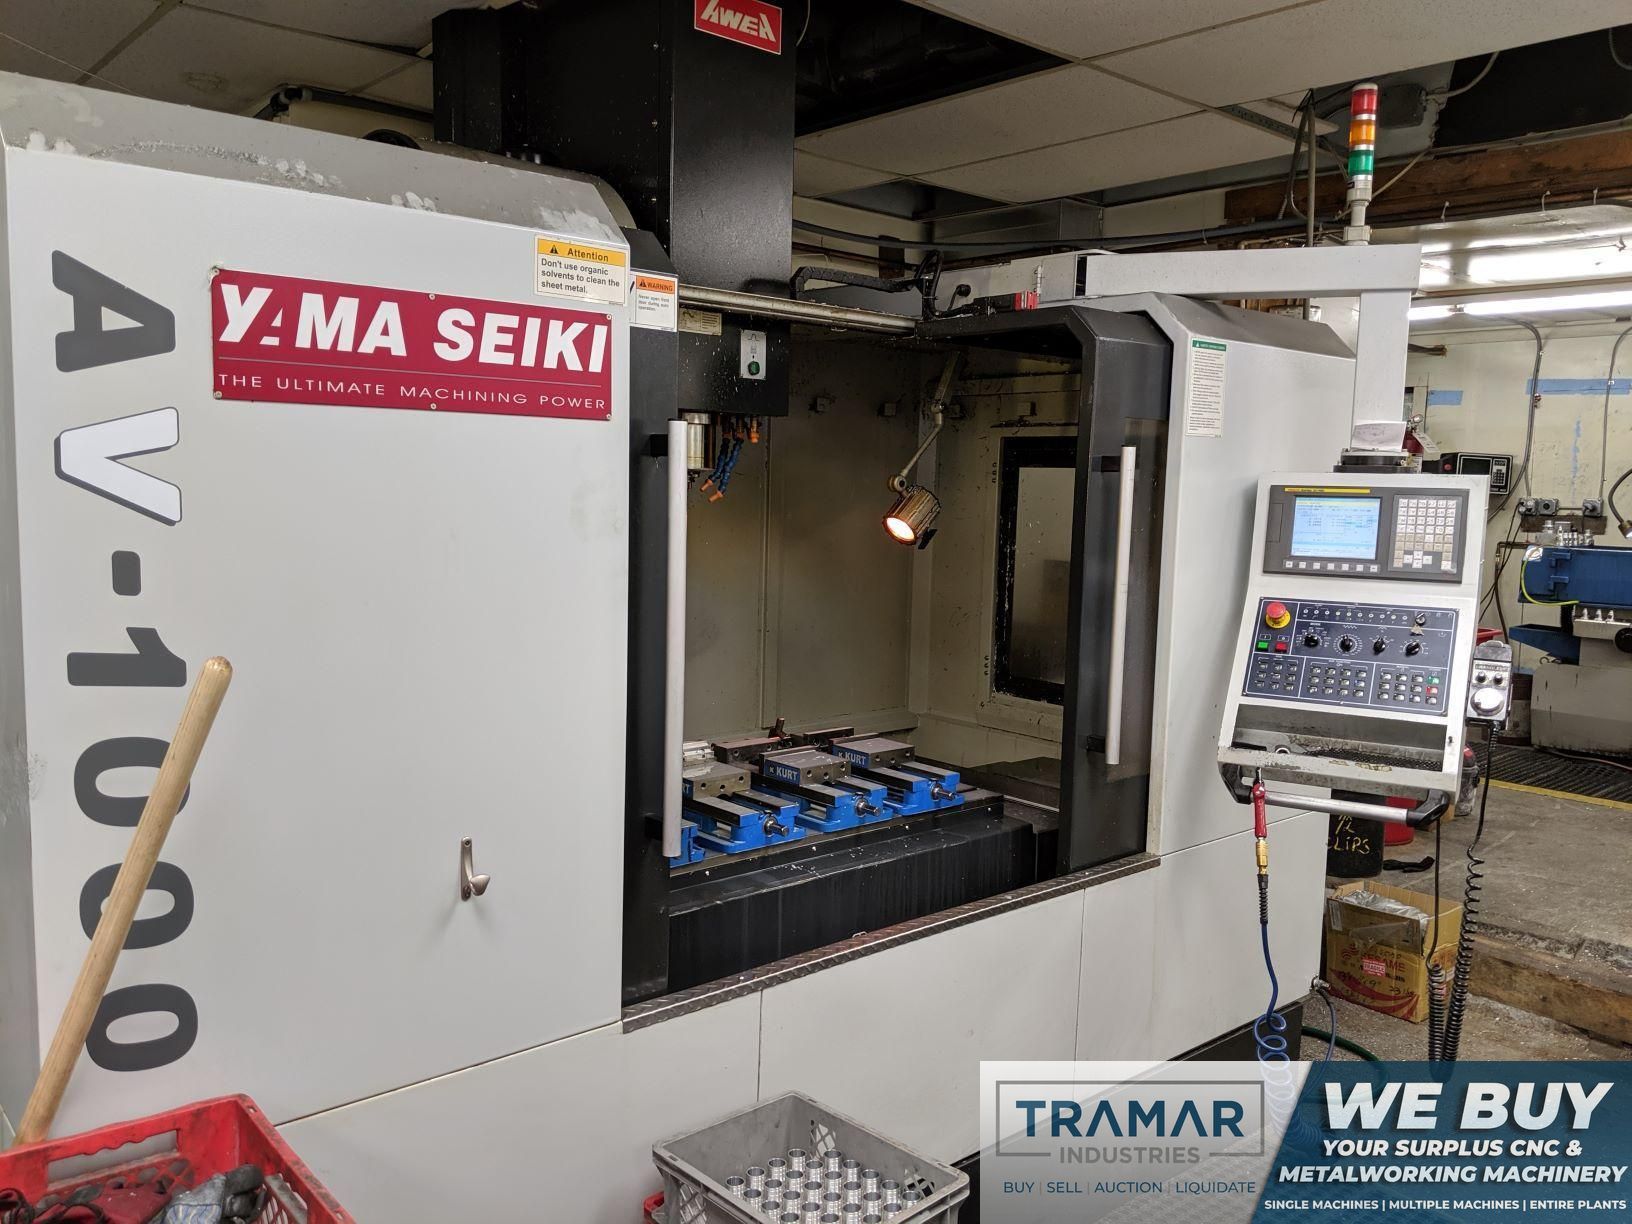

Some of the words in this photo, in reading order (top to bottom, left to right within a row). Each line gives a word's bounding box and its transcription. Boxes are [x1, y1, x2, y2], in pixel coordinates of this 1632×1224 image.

[701, 0, 776, 42] AWEA
[567, 247, 609, 262] Attention
[541, 258, 562, 268] Don't
[564, 263, 578, 271] use
[580, 265, 608, 276] organic
[541, 270, 575, 281] solvents
[576, 274, 584, 282] to
[586, 276, 606, 286] clean
[608, 279, 620, 287] the
[541, 280, 563, 290] sheet
[564, 284, 588, 294] metal.
[647, 282, 673, 292] WARNING
[219, 283, 407, 356] YAMA
[433, 308, 608, 373] SEIKI
[218, 374, 263, 388] THE
[276, 377, 385, 396] ULTIMATE
[400, 385, 528, 404] MACHINING
[540, 395, 605, 409] POWER
[52, 250, 197, 1072] AV-1000
[845, 752, 867, 766] KURT
[776, 766, 798, 781] KURT
